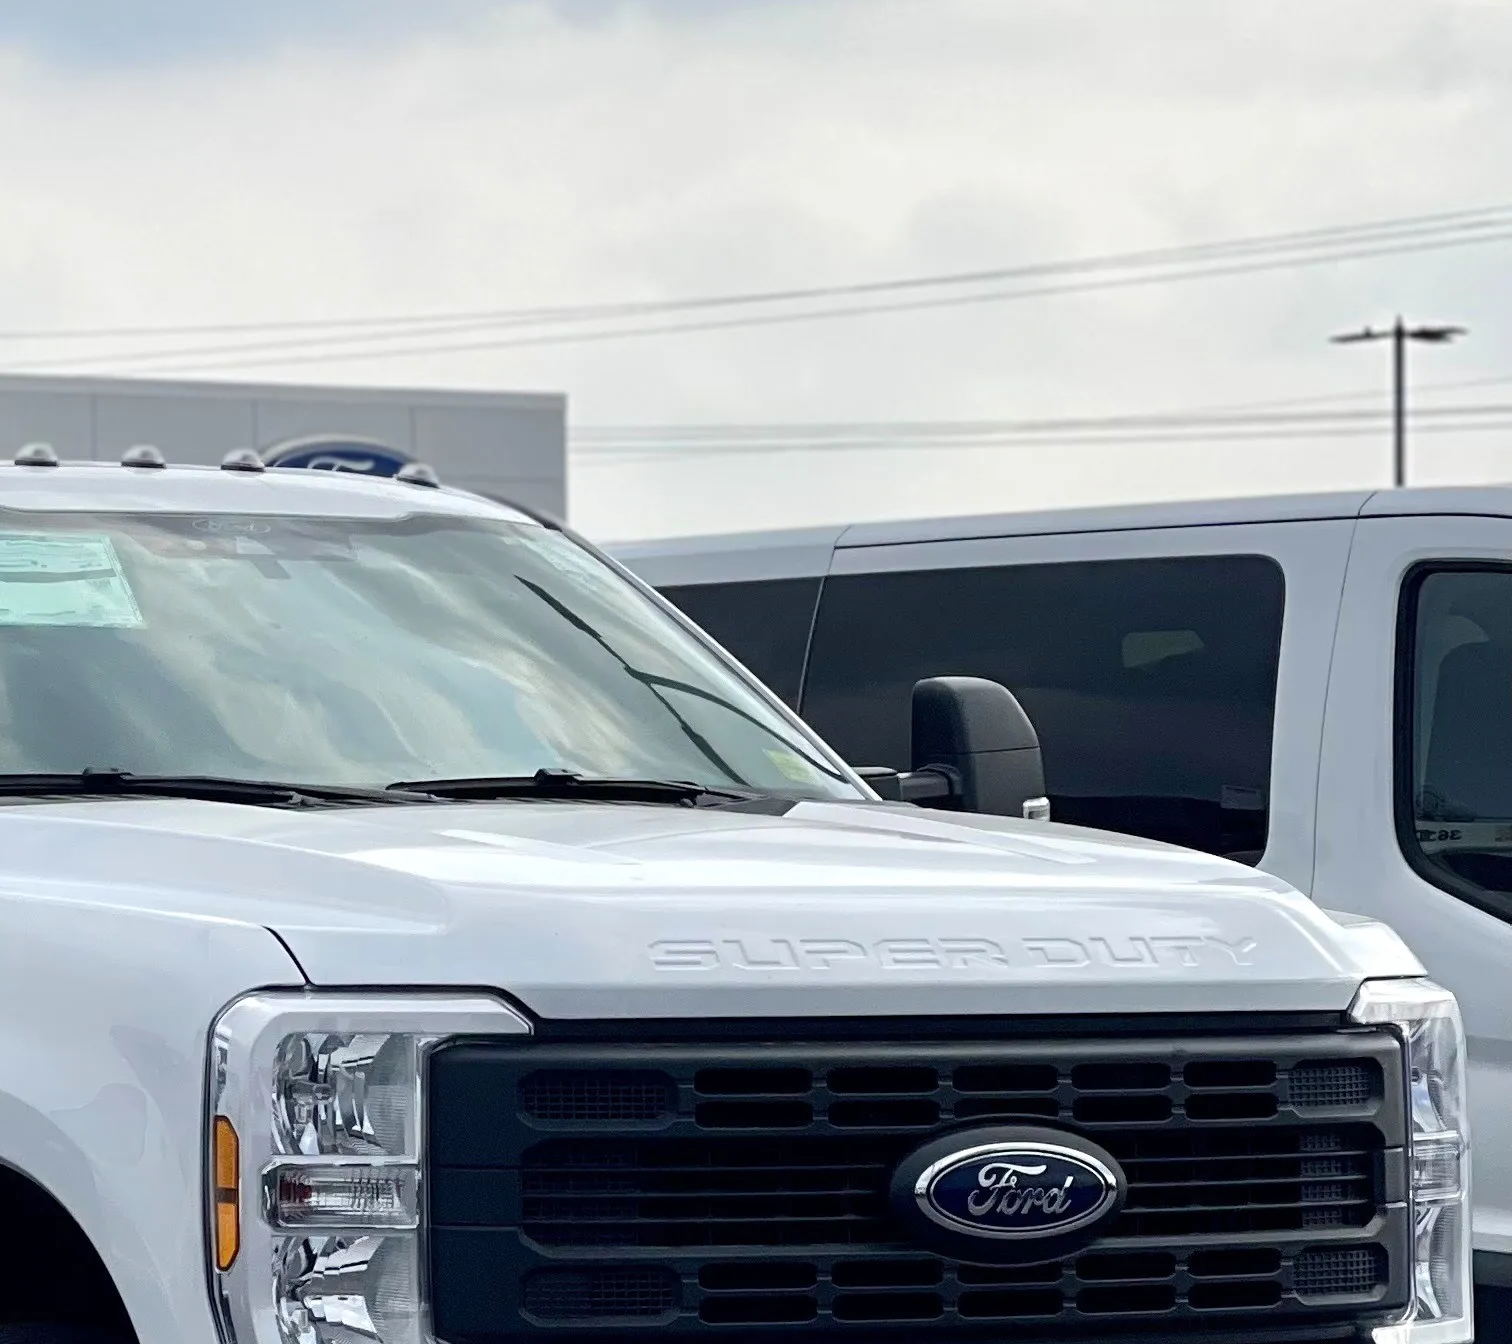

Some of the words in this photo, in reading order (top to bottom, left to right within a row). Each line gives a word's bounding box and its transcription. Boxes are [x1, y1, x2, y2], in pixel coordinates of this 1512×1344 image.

[648, 938, 1009, 971] SUPER
[1022, 935, 1258, 968] DUTY
[967, 1162, 1074, 1217] Ford
